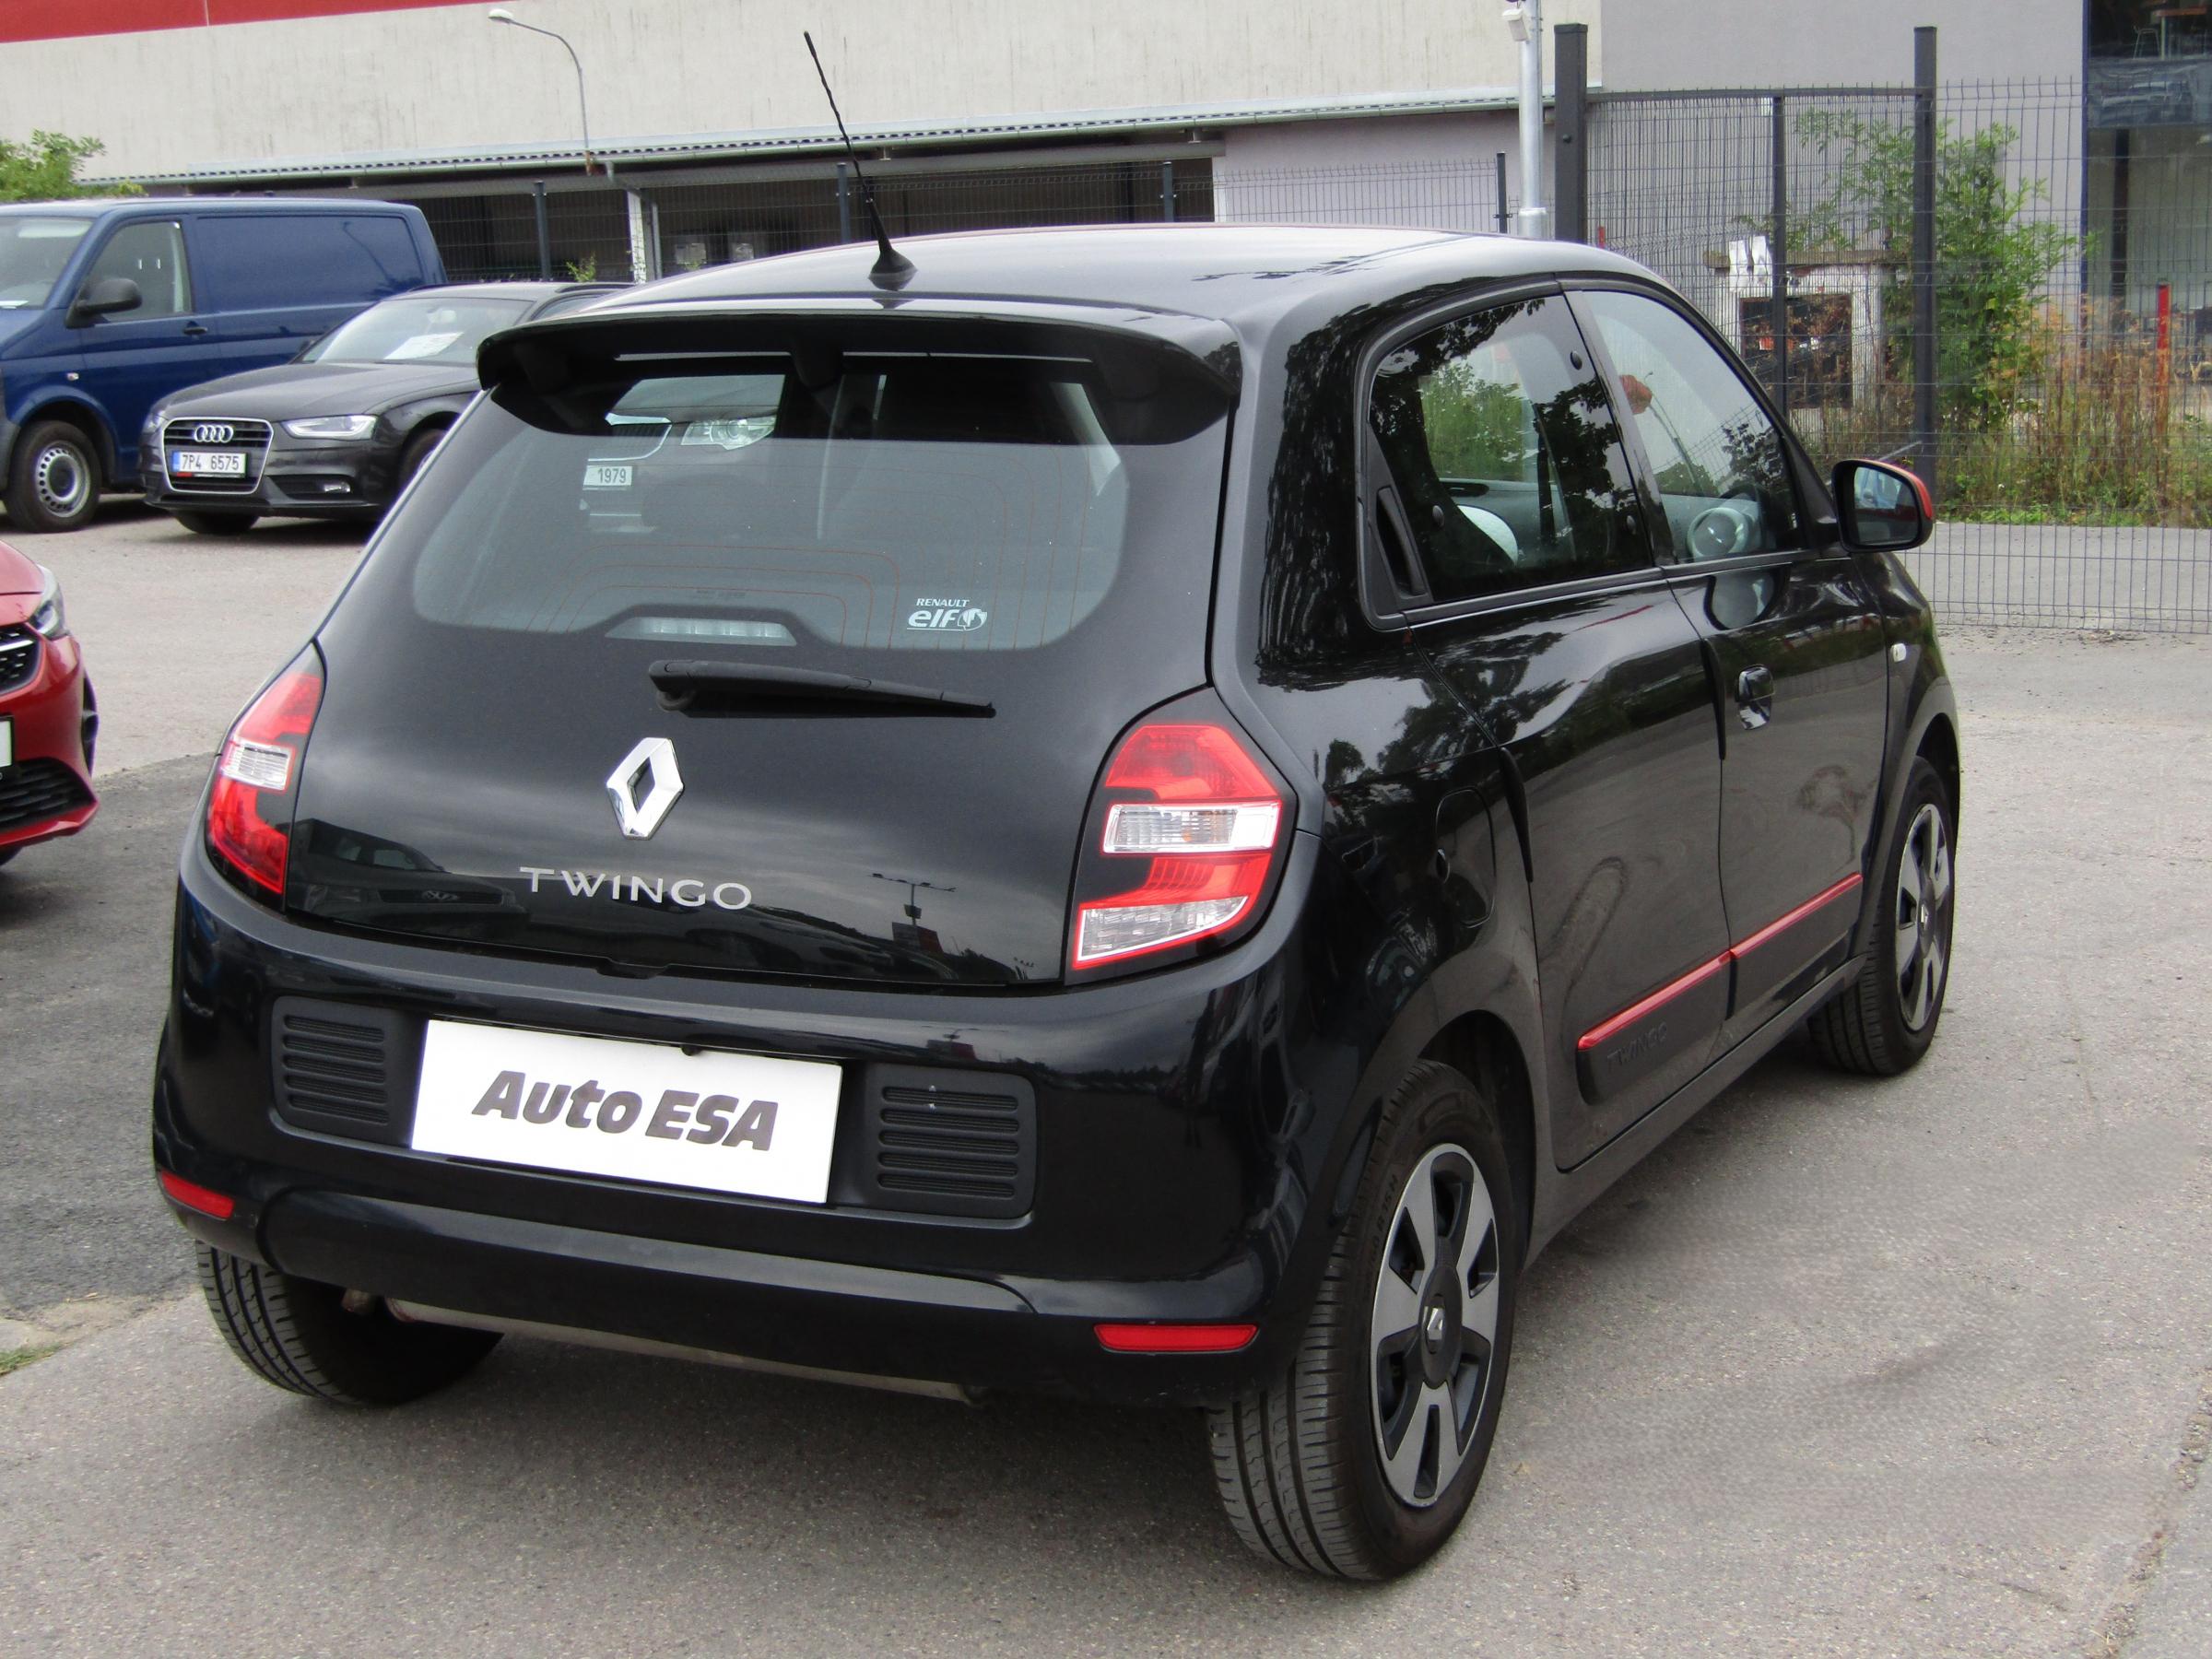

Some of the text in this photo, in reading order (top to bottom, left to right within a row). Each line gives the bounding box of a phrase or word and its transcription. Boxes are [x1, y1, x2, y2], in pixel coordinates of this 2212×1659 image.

[182, 454, 202, 470] 7P4
[210, 455, 240, 471] 6575
[597, 467, 627, 484] 1979
[915, 597, 971, 607] RENAULT
[908, 608, 960, 628] elf
[519, 866, 752, 911] TWINGO
[471, 1070, 779, 1152] Auto ESA
